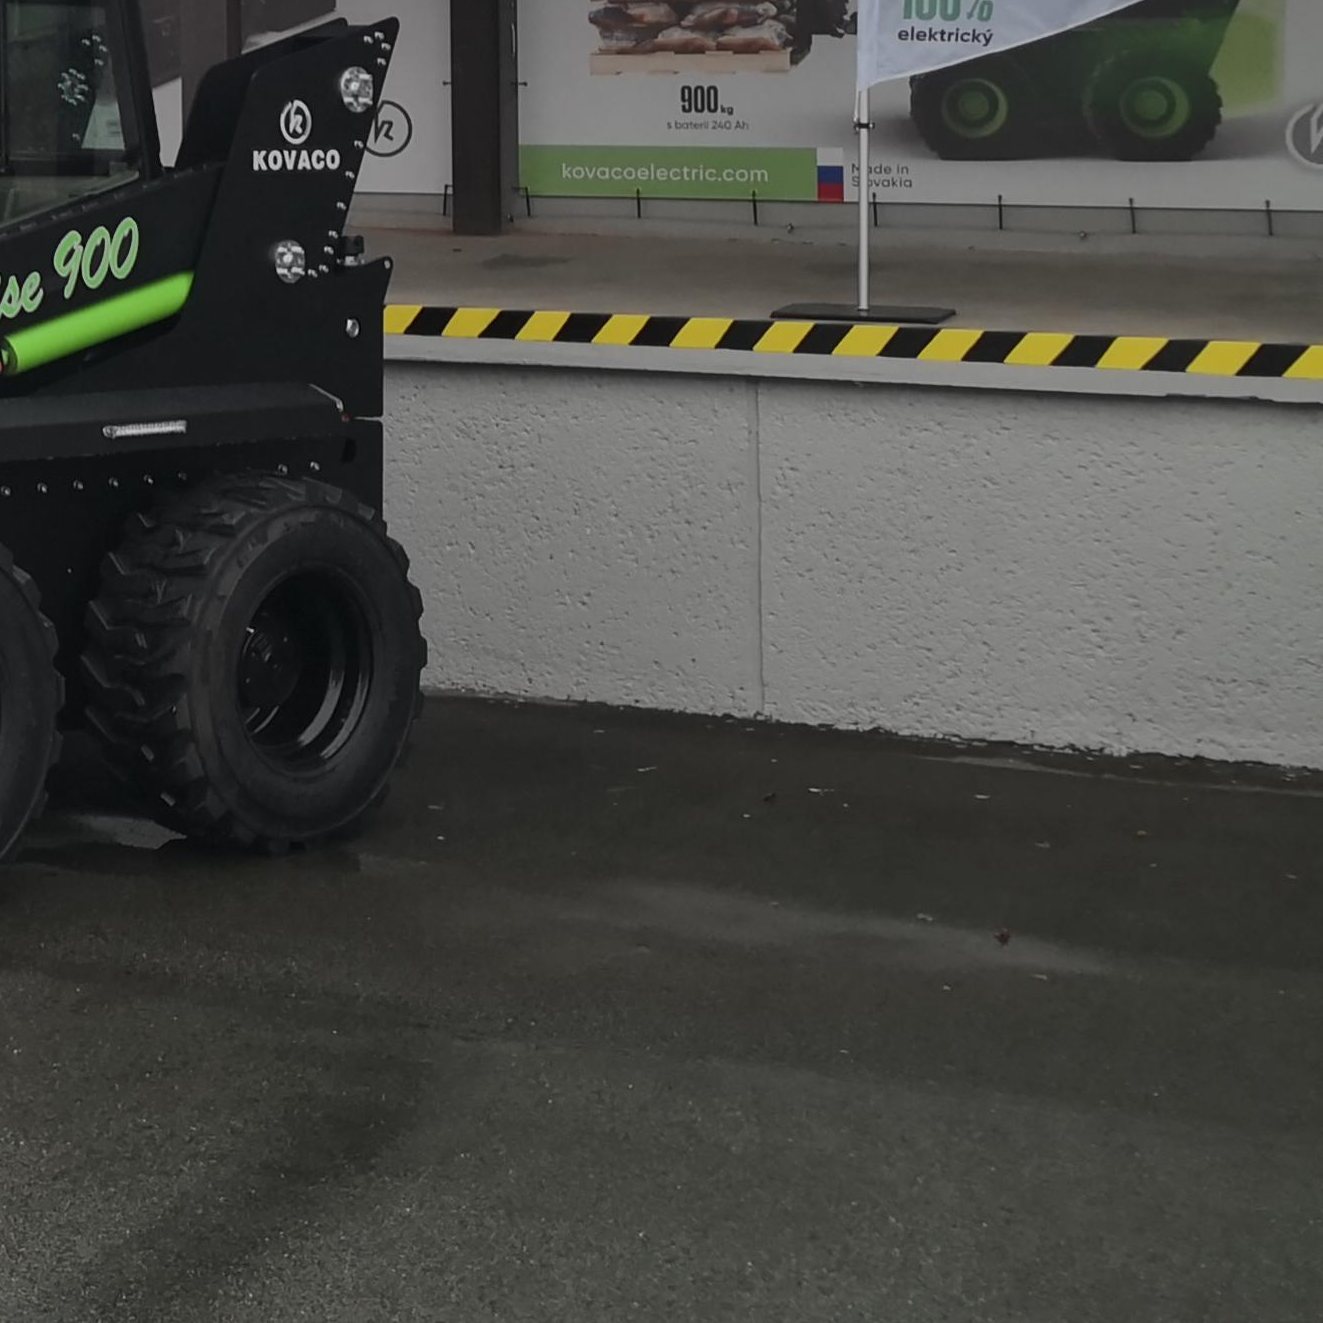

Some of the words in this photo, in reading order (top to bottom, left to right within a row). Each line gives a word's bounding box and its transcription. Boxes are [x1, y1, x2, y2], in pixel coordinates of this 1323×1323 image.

[898, 26, 993, 47] elektrický
[681, 85, 719, 113] 900
[721, 105, 733, 115] kg
[711, 120, 732, 130] 240
[734, 119, 749, 130] Ah
[252, 149, 341, 172] KOVACO
[897, 163, 909, 174] in
[561, 162, 769, 183] kovacoelectric.com
[851, 176, 913, 188] Sovakia
[53, 216, 140, 299] 900
